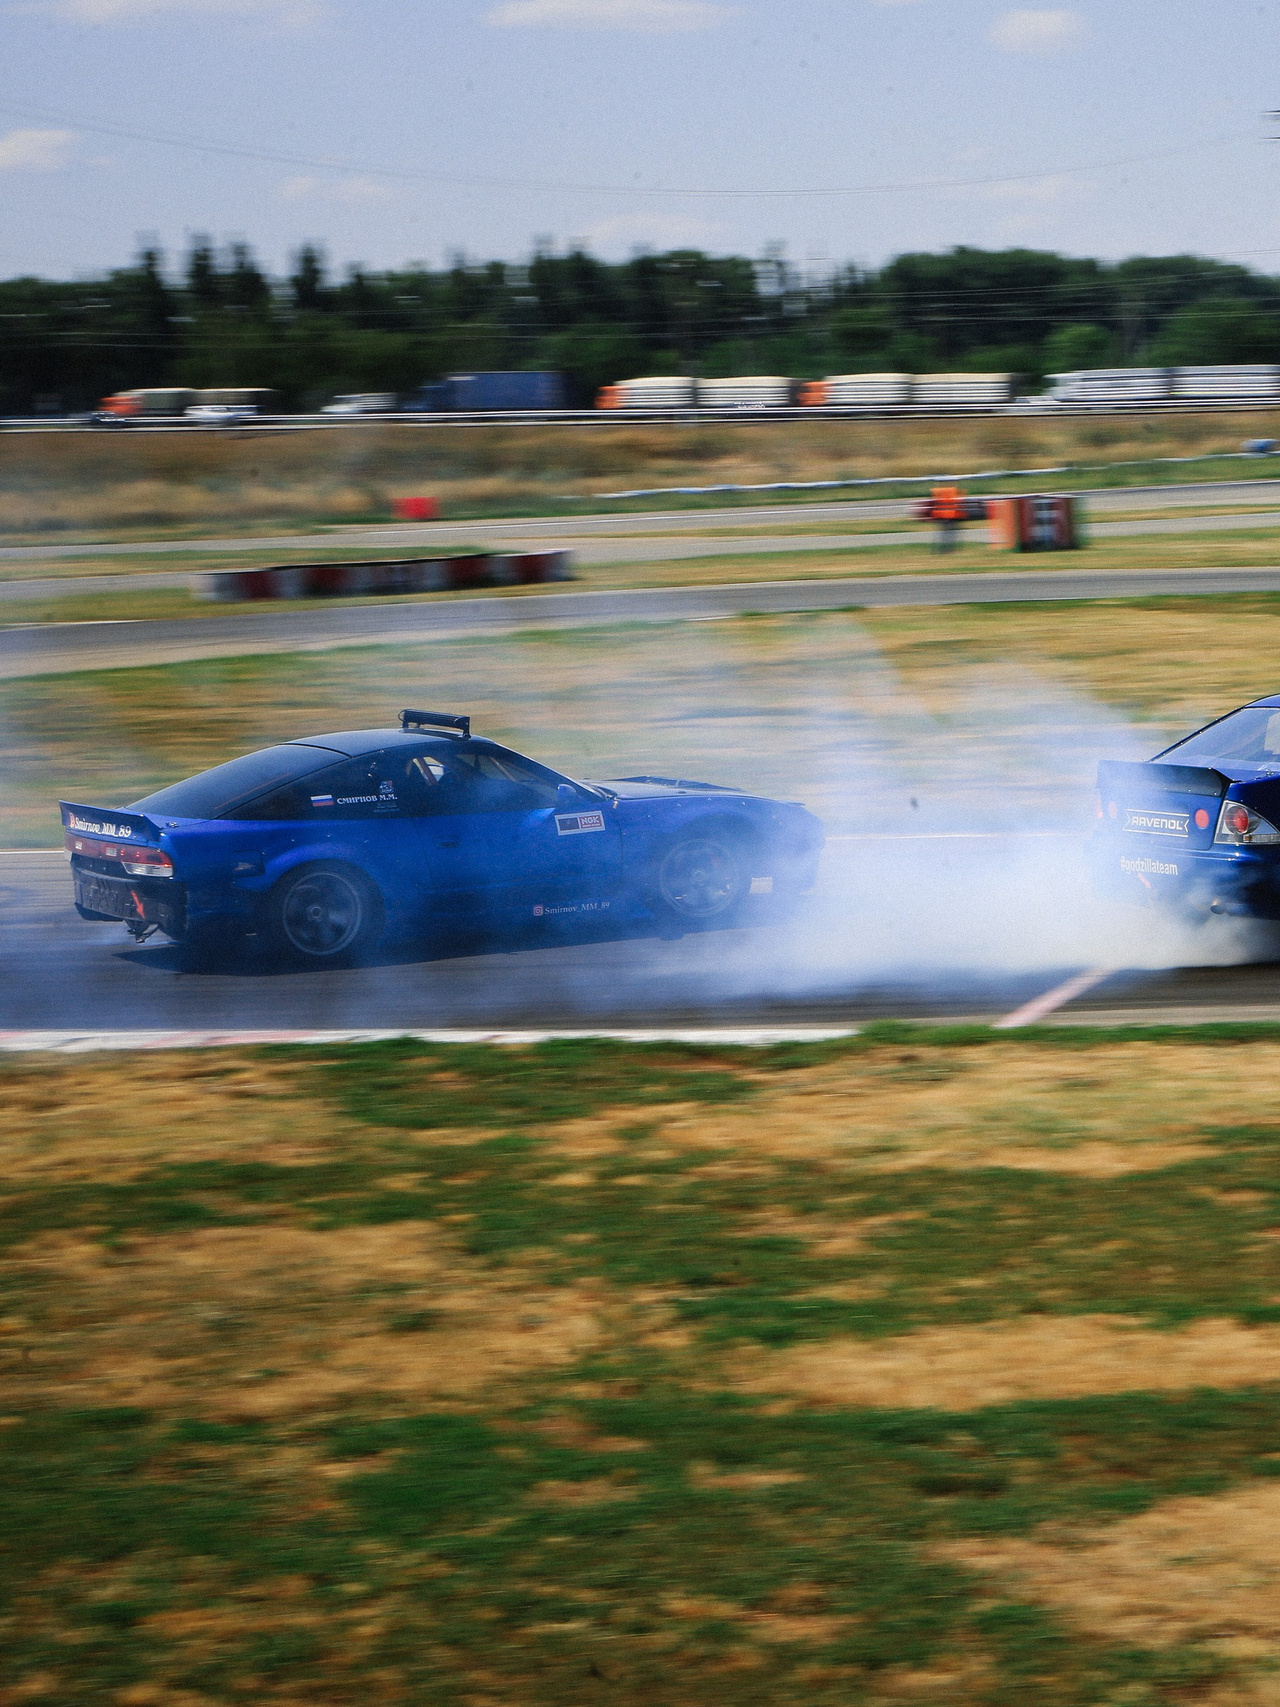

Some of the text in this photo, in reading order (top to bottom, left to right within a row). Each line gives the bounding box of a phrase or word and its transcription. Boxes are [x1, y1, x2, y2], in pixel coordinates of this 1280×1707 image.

[337, 793, 398, 805] СМИРНОВ М.М.
[75, 817, 131, 838] Smirnov_MM_89
[580, 816, 600, 825] NGK
[1131, 816, 1183, 831] RAVENOL
[1120, 856, 1179, 876] #godzillateam
[544, 902, 610, 915] Smirnov_MM_89
